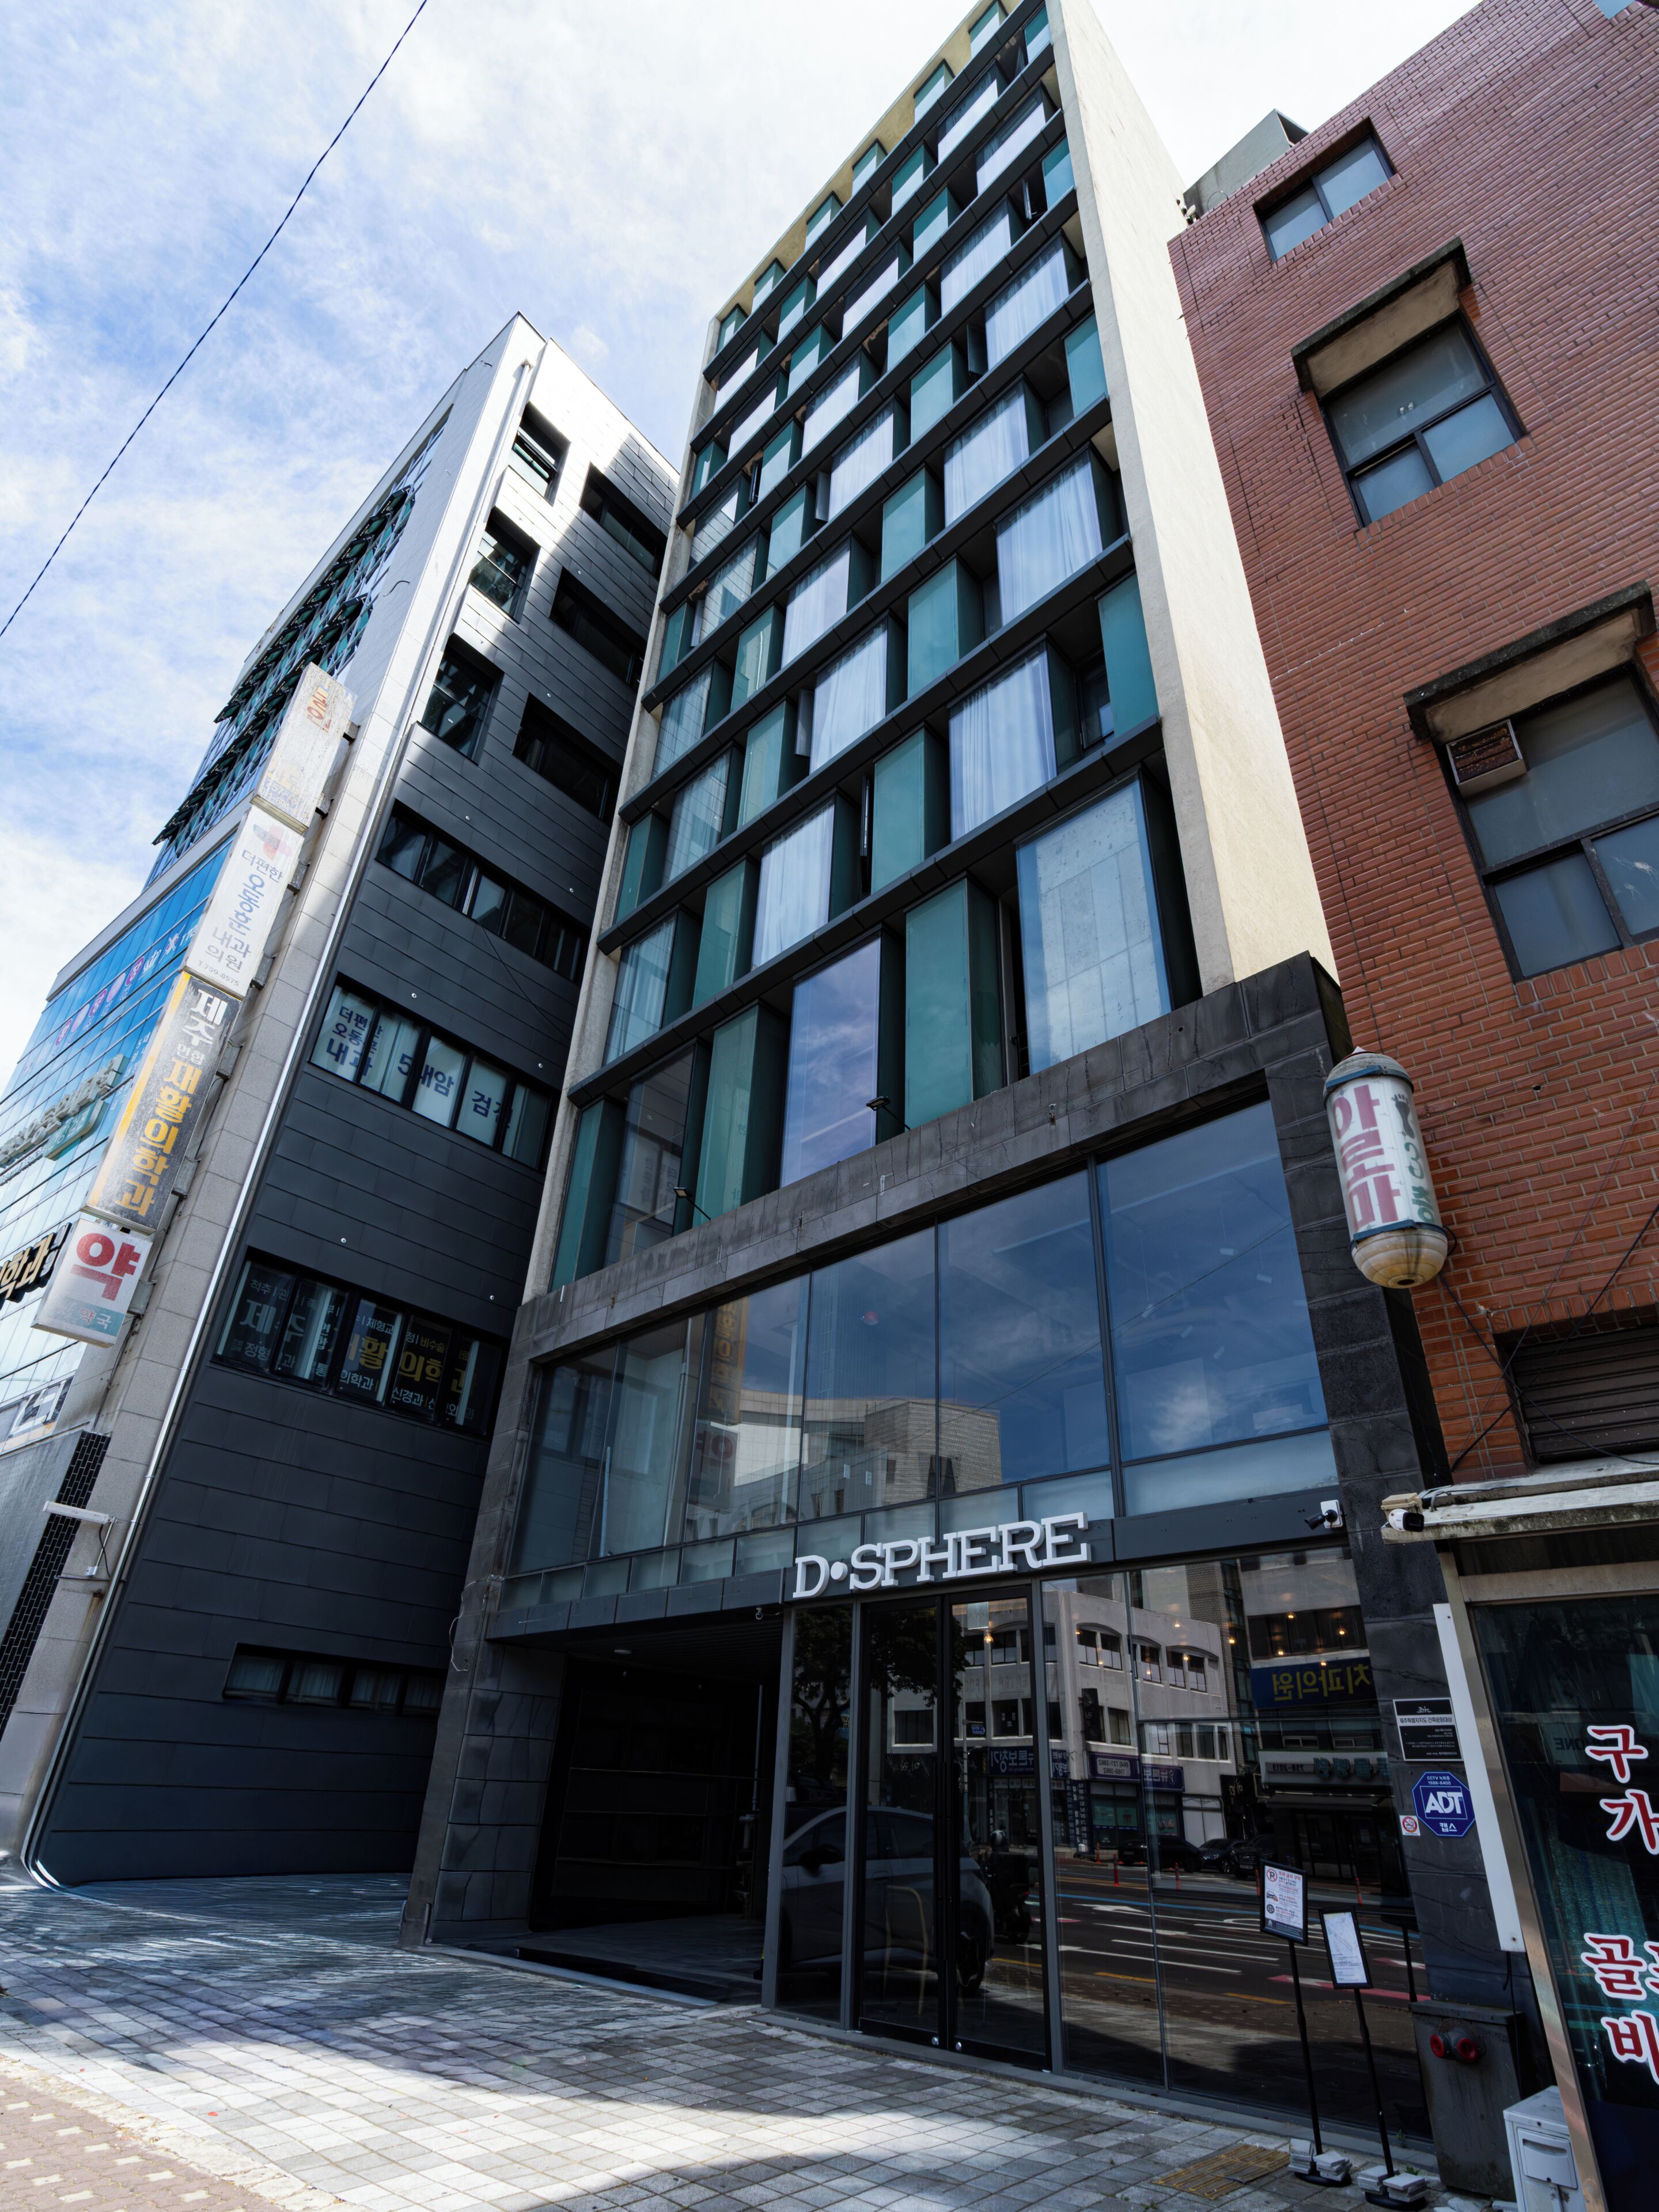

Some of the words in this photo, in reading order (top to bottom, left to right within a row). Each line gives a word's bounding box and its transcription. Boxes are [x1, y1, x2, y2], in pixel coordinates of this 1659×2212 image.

[242, 849, 284, 884] 더편한
[204, 944, 243, 973] 의원
[212, 926, 251, 959] 내과
[182, 988, 229, 1047] 제주
[115, 1056, 202, 1217] 재활의학과
[1331, 1084, 1401, 1232] 아로마
[70, 1232, 141, 1302] 약
[250, 1279, 272, 1294] 척추
[392, 1387, 423, 1407] 신경과
[1425, 1791, 1464, 1815] ADT
[1440, 1822, 1458, 1833] 캡스
